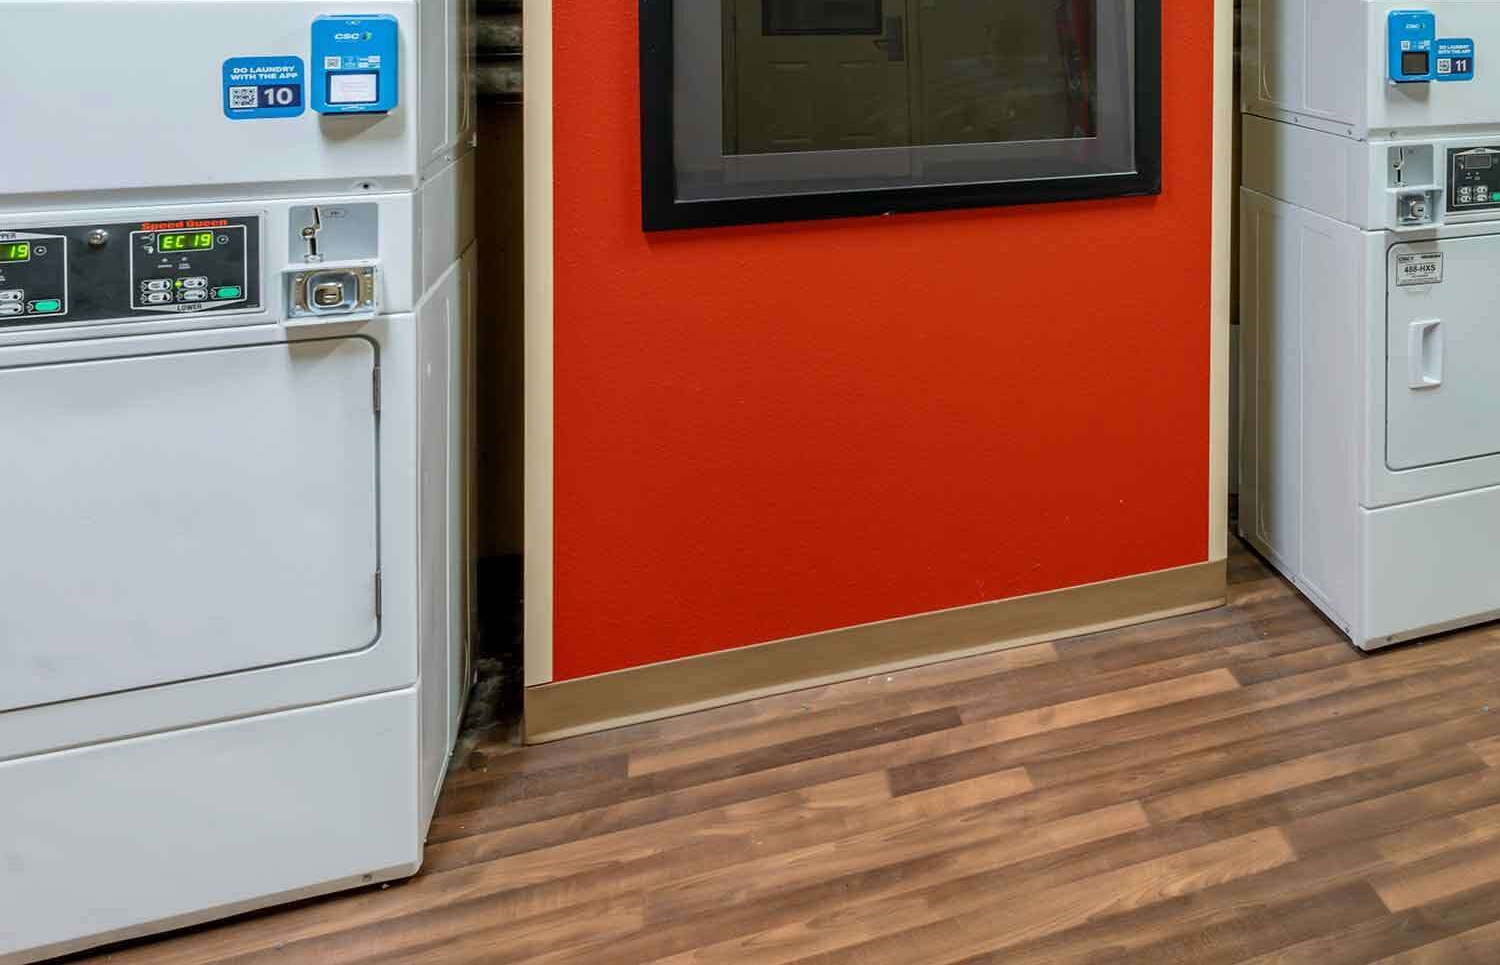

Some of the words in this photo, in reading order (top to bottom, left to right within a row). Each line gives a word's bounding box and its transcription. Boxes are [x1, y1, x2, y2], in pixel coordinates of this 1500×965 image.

[250, 65, 295, 73] LAUNDRY
[1455, 60, 1466, 72] 11
[263, 87, 293, 106] 10
[141, 220, 184, 231] Speed
[194, 233, 212, 247] 19
[10, 244, 28, 258] 19
